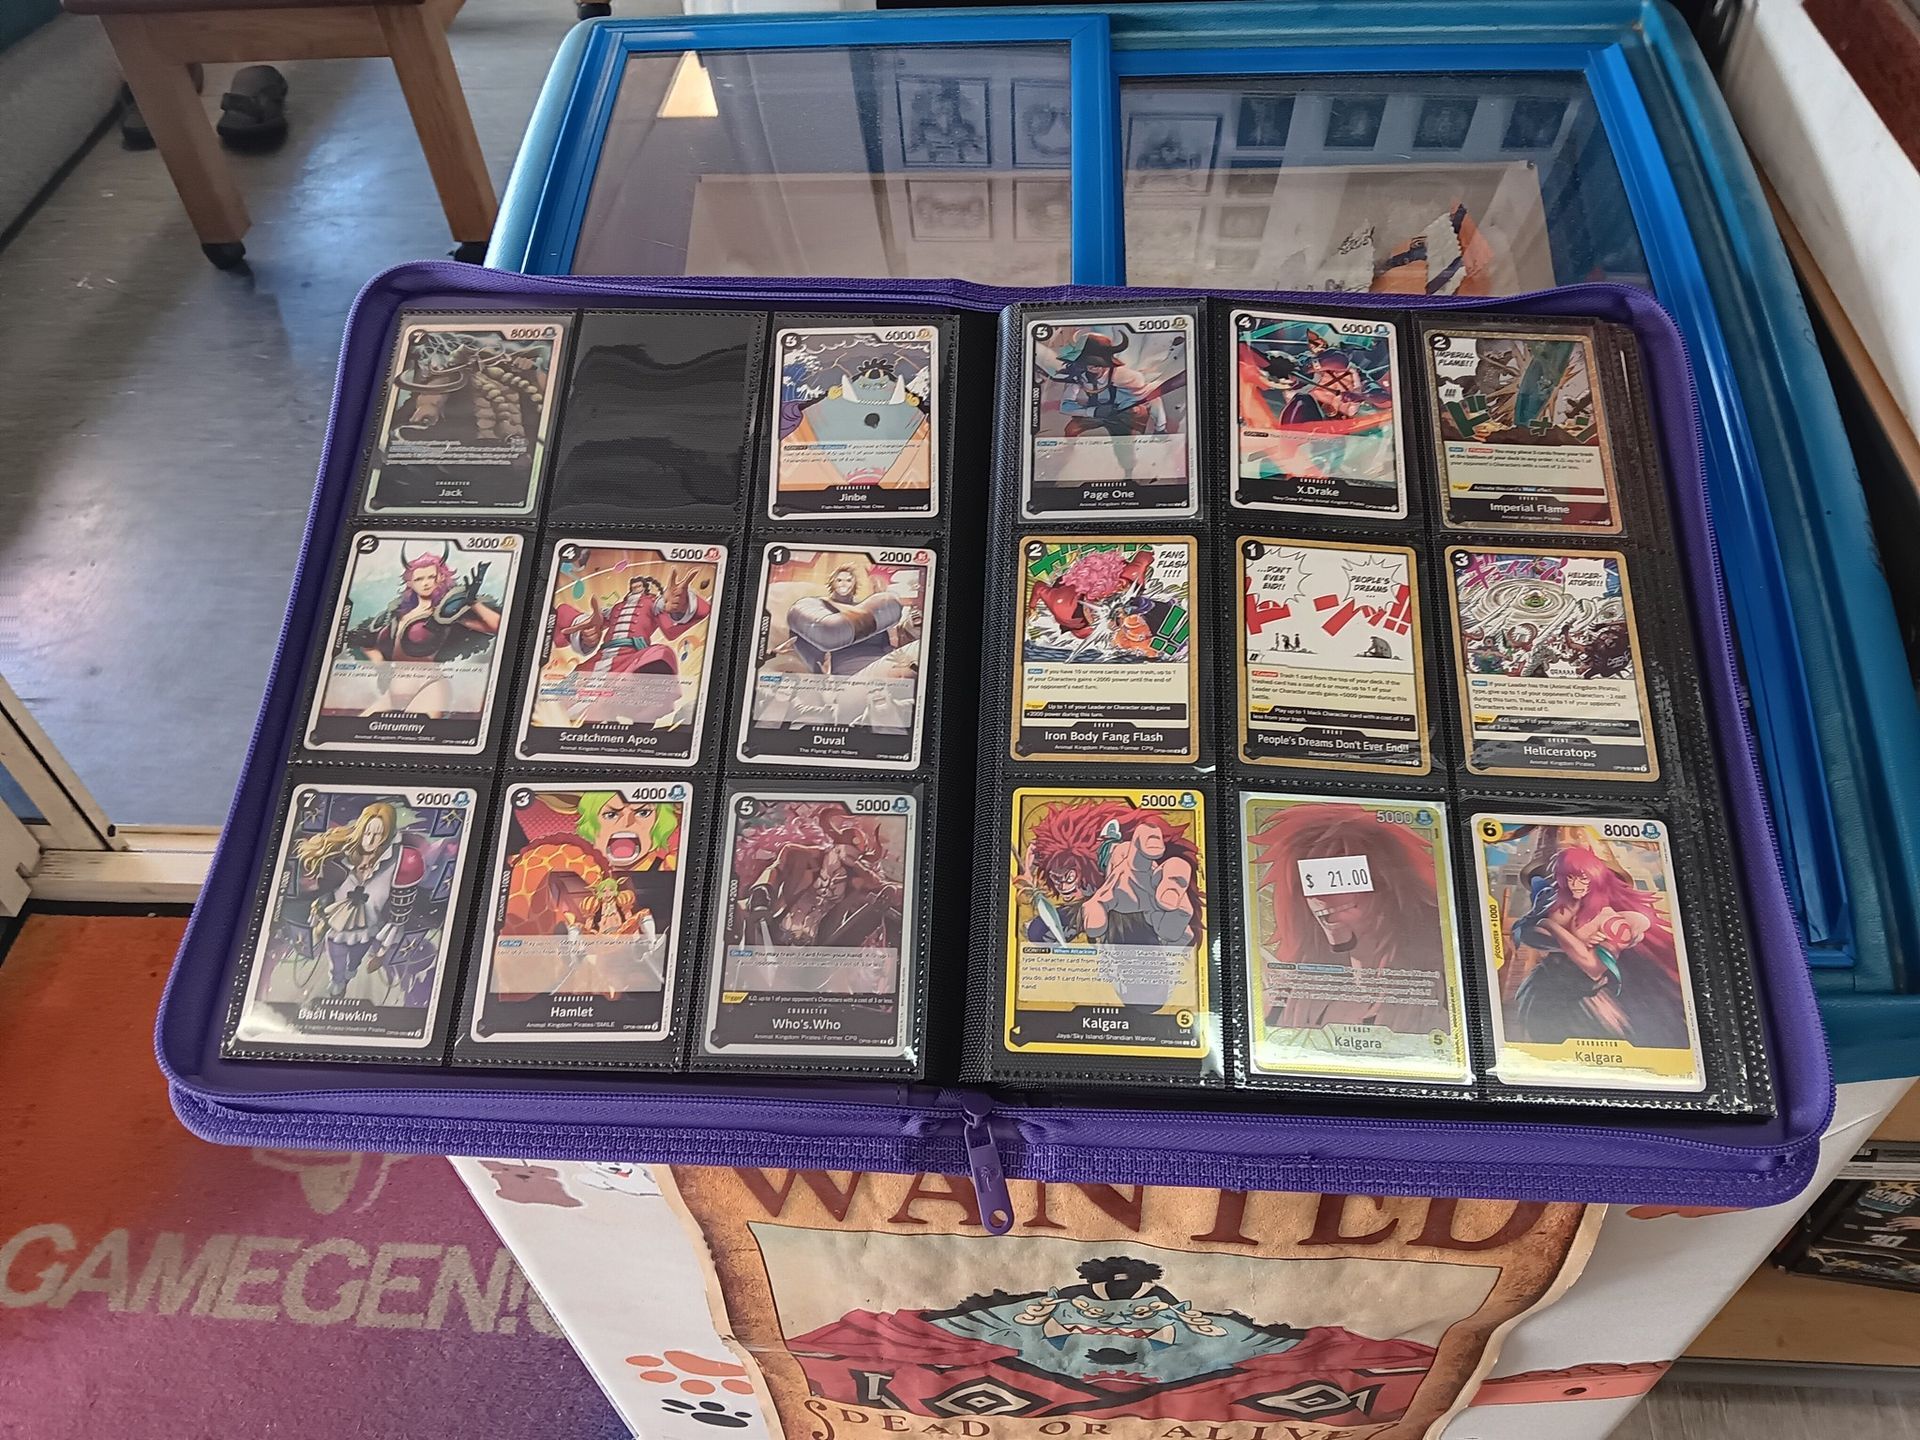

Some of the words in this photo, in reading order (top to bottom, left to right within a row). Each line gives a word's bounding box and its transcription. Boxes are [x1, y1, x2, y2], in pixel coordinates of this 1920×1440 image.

[1138, 320, 1170, 330] 5000
[1238, 317, 1252, 328] 4
[510, 328, 540, 339] 8000
[1036, 327, 1048, 339] 5
[1341, 324, 1374, 334] 6000
[413, 331, 424, 344] 7
[885, 331, 915, 340] 6000
[784, 337, 798, 347] 5
[1433, 336, 1447, 348] 2
[438, 488, 463, 497] Jack
[838, 493, 867, 502] Jinbe
[1083, 490, 1109, 500] Page
[1112, 490, 1135, 498] One
[1296, 486, 1340, 497] X.Drake
[1490, 503, 1534, 514] Imperial
[1537, 504, 1571, 514] Flame
[361, 538, 376, 550] 2
[466, 538, 500, 549] 3000
[561, 547, 576, 559] 4
[670, 549, 703, 559] 5000
[773, 550, 783, 562] 1
[1028, 544, 1043, 557] 2
[1159, 551, 1186, 559] FANG
[1247, 544, 1257, 557] 1
[879, 552, 912, 563] 2000
[1455, 553, 1469, 567] 3
[1156, 560, 1188, 569] FLASH
[1262, 574, 1286, 582] EVER
[1353, 585, 1389, 593] DREAMS
[369, 721, 425, 733] Ginrummy
[559, 731, 627, 744] Scratchmen
[628, 735, 658, 745] Apoo
[813, 735, 845, 746] Duval
[1044, 731, 1067, 741] Iron
[1070, 731, 1098, 743] Body
[1102, 732, 1130, 743] Fang
[1133, 732, 1163, 742] Flash
[1258, 734, 1296, 746] People's
[1298, 737, 1334, 748] Dreams
[1336, 740, 1361, 750] Don't
[1363, 741, 1384, 752] Ever
[1523, 746, 1597, 759] Heliceratops
[416, 793, 451, 805] 9000
[631, 788, 667, 799] 4000
[303, 793, 317, 807] 7
[516, 793, 530, 807] 3
[855, 800, 891, 811] 5000
[1141, 795, 1177, 807] 5000
[739, 801, 754, 814] 5
[1376, 810, 1413, 824] 5000
[1482, 823, 1497, 837] 6
[1604, 824, 1641, 838] 8000
[1305, 874, 1315, 889] $
[1327, 868, 1369, 888] 21.00
[298, 1008, 325, 1020] Basil
[329, 1010, 378, 1022] Hawkins
[550, 1006, 594, 1017] Hamlet
[772, 1018, 841, 1030] Who's.Who
[1082, 1018, 1129, 1031] Kalgara
[1180, 1014, 1190, 1025] 5
[1334, 1036, 1382, 1050] Kalgara
[1433, 1035, 1443, 1045] 5
[1574, 1051, 1623, 1064] Kalgara
[0, 1223, 565, 1339] GAMEGEN!
[839, 1407, 990, 1438] DEAD
[1038, 1421, 1112, 1436] OR
